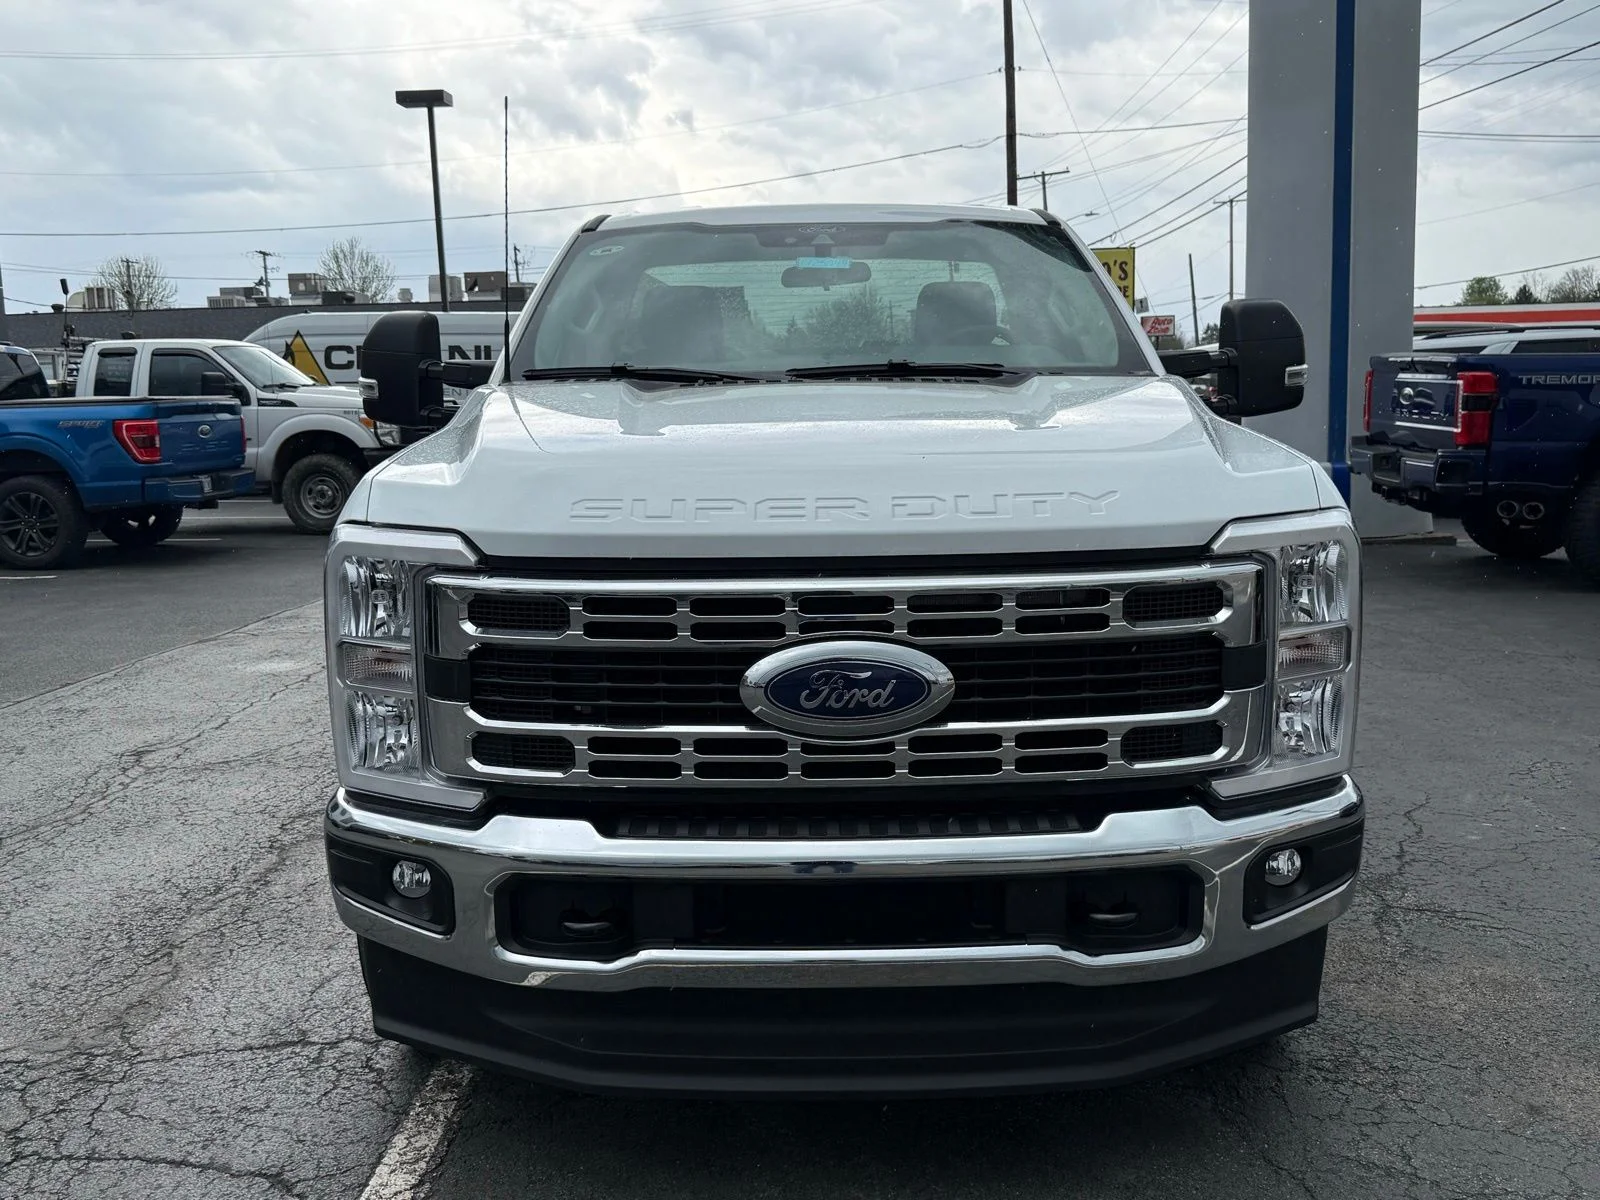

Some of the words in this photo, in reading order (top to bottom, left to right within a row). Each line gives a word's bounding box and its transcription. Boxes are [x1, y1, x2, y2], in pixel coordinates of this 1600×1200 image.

[569, 497, 869, 523] SUPER
[891, 489, 1120, 520] DUTY
[799, 669, 897, 710] Ford
